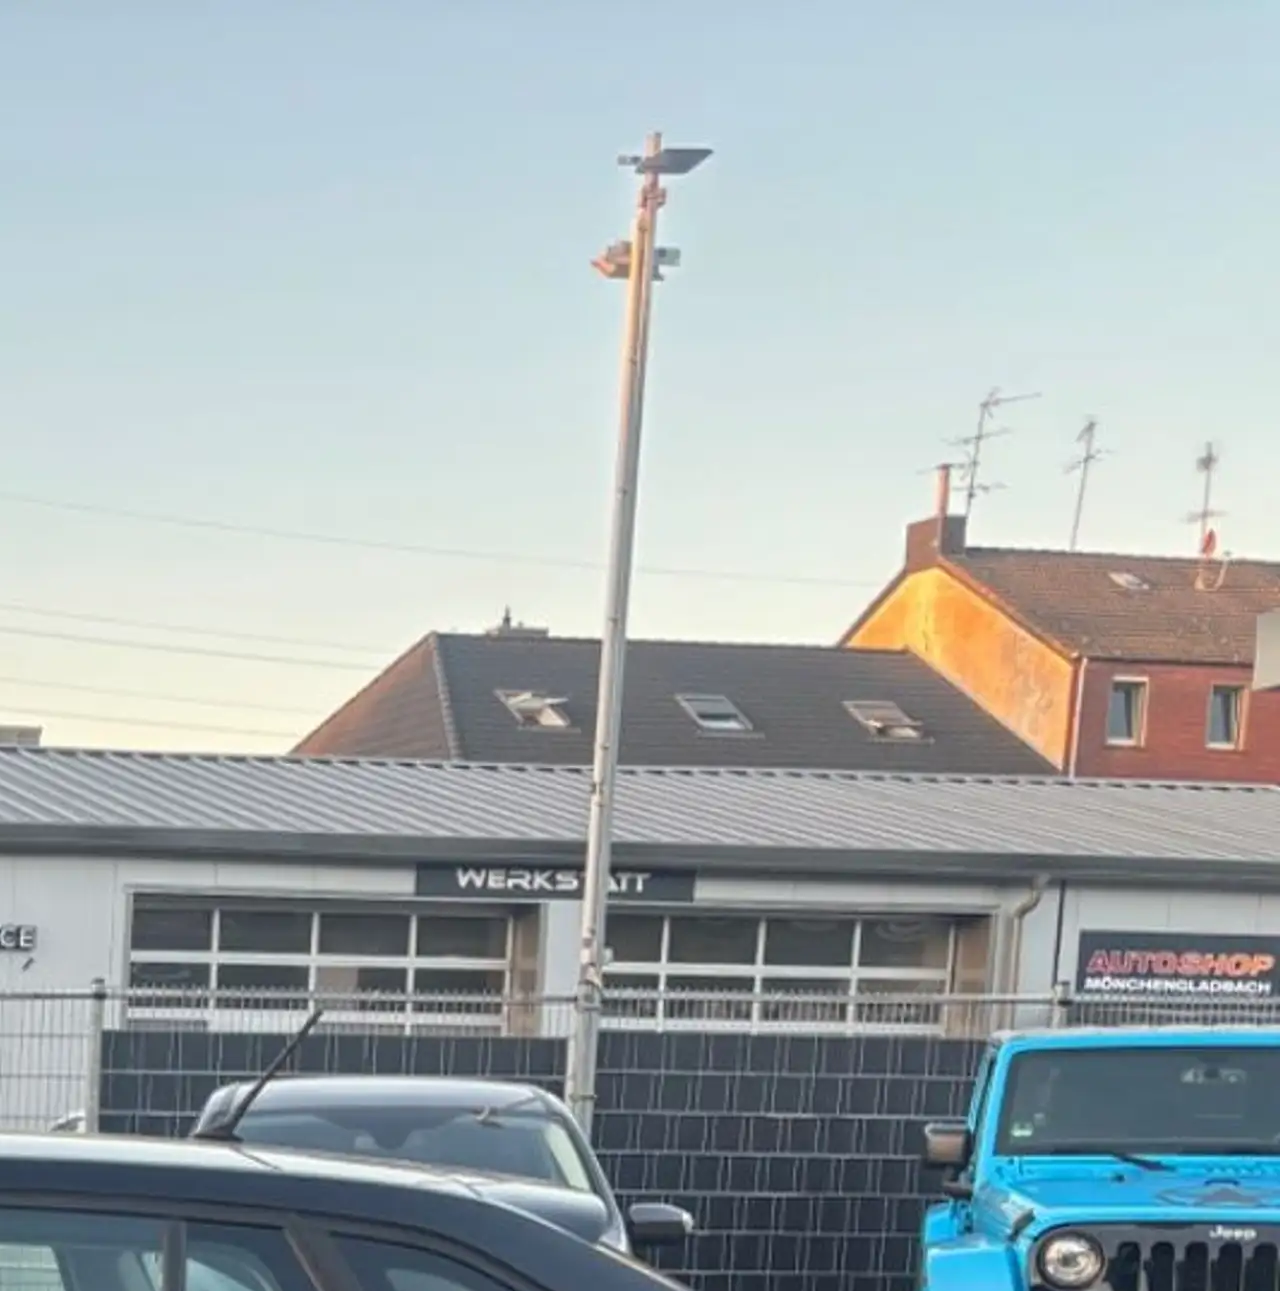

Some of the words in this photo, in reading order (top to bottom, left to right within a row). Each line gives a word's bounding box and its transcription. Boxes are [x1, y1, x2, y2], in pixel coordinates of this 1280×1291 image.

[455, 867, 651, 893] WERKSTT
[1085, 949, 1276, 977] AUTOSHOP
[1083, 975, 1272, 995] MÖNCHENGLADBACH
